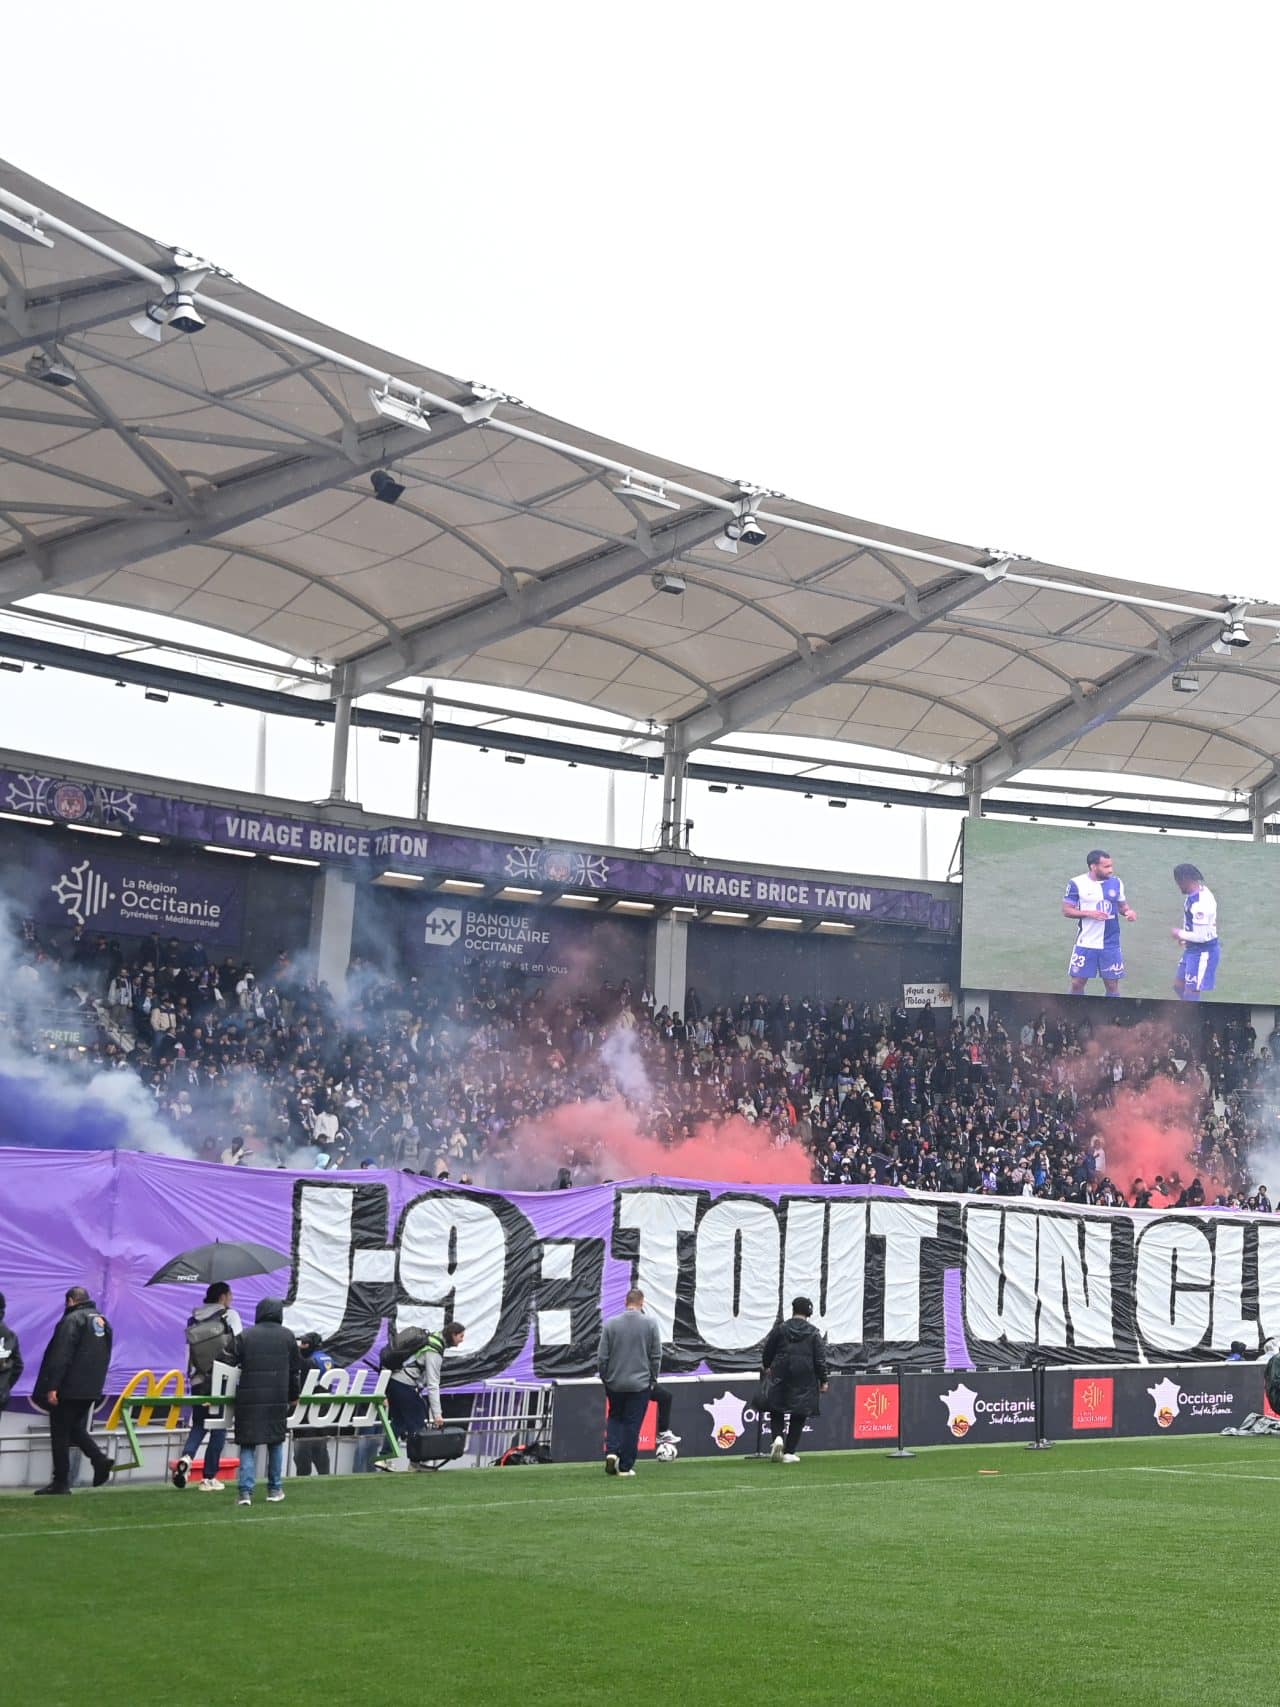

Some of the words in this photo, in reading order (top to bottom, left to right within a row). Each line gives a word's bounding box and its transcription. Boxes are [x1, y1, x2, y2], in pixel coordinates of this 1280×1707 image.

[225, 816, 303, 848] VIRAGE
[309, 830, 370, 857] BRICE
[375, 834, 428, 858] TATON
[122, 877, 135, 889] La
[138, 880, 177, 895] Région
[685, 873, 751, 898] VIRAGE
[756, 882, 809, 904] BRICE
[815, 888, 871, 911] TATON
[121, 891, 221, 918] Occitanie
[466, 912, 529, 929] BANQUE
[466, 925, 550, 944] POPULAIRE
[464, 938, 524, 954] OCCITANE
[619, 1191, 938, 1350] TOUT
[964, 1205, 1114, 1348] UN
[975, 1398, 1036, 1413] Occitanie
[1178, 1391, 1234, 1405] Occitanie
